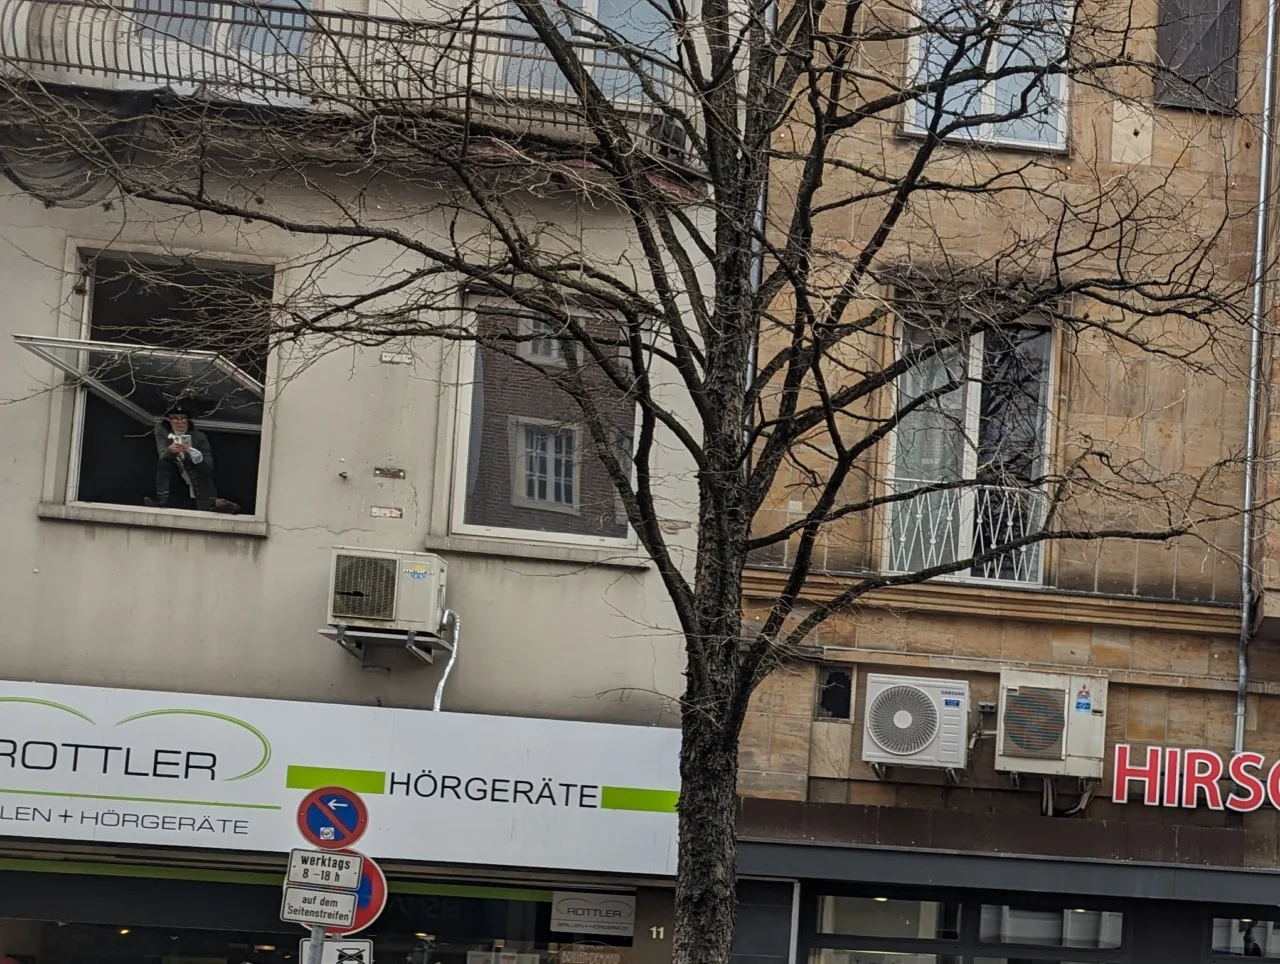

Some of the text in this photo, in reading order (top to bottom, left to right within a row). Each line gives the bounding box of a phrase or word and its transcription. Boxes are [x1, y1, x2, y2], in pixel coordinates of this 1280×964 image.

[389, 769, 599, 809] HÖRGERÄTE
[58, 809, 73, 824] +
[80, 809, 250, 835] HÖRGERÄTE
[301, 855, 351, 871] werktags
[302, 868, 309, 879] 8
[334, 873, 340, 882] h
[302, 896, 338, 908] auf dem
[287, 905, 349, 921] Seitenstreifen
[567, 907, 622, 918] ROTTLER
[649, 926, 665, 939] 11
